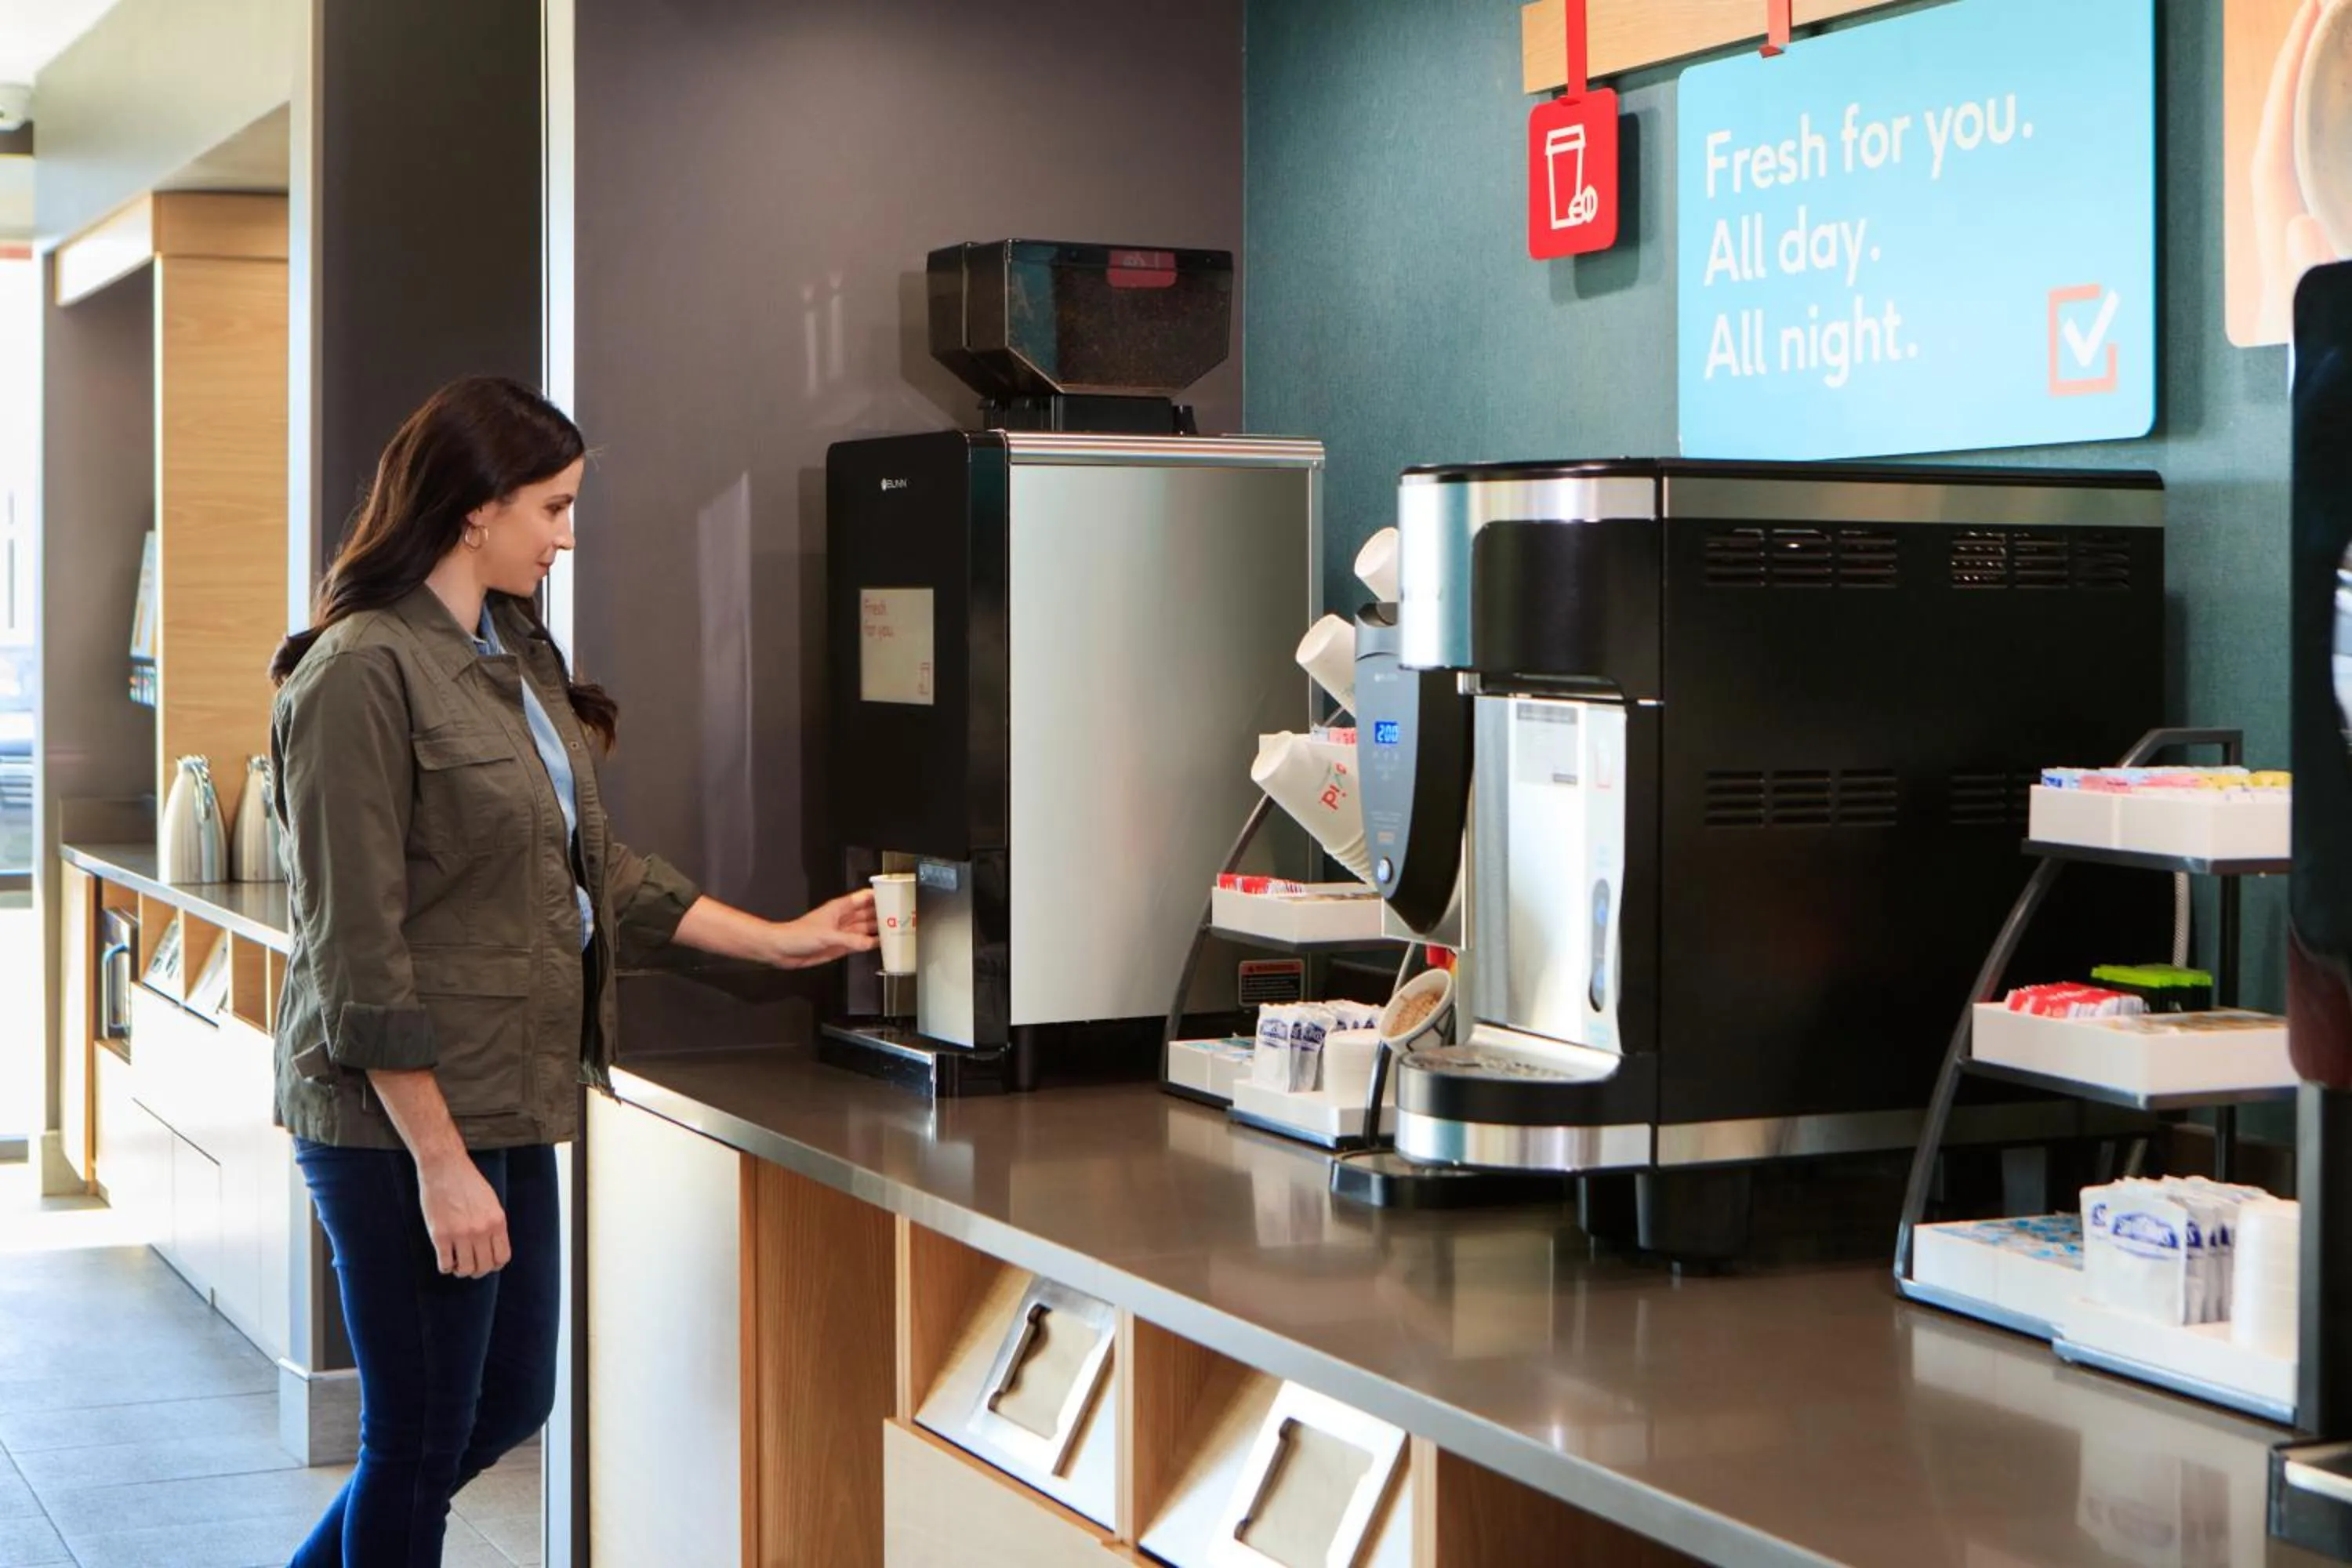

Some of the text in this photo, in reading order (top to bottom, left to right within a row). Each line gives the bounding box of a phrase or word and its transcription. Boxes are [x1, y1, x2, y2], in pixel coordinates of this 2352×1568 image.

[1704, 93, 2034, 199] Fresh for you.
[1703, 205, 1881, 288] All day.
[1703, 295, 1919, 389] All night.
